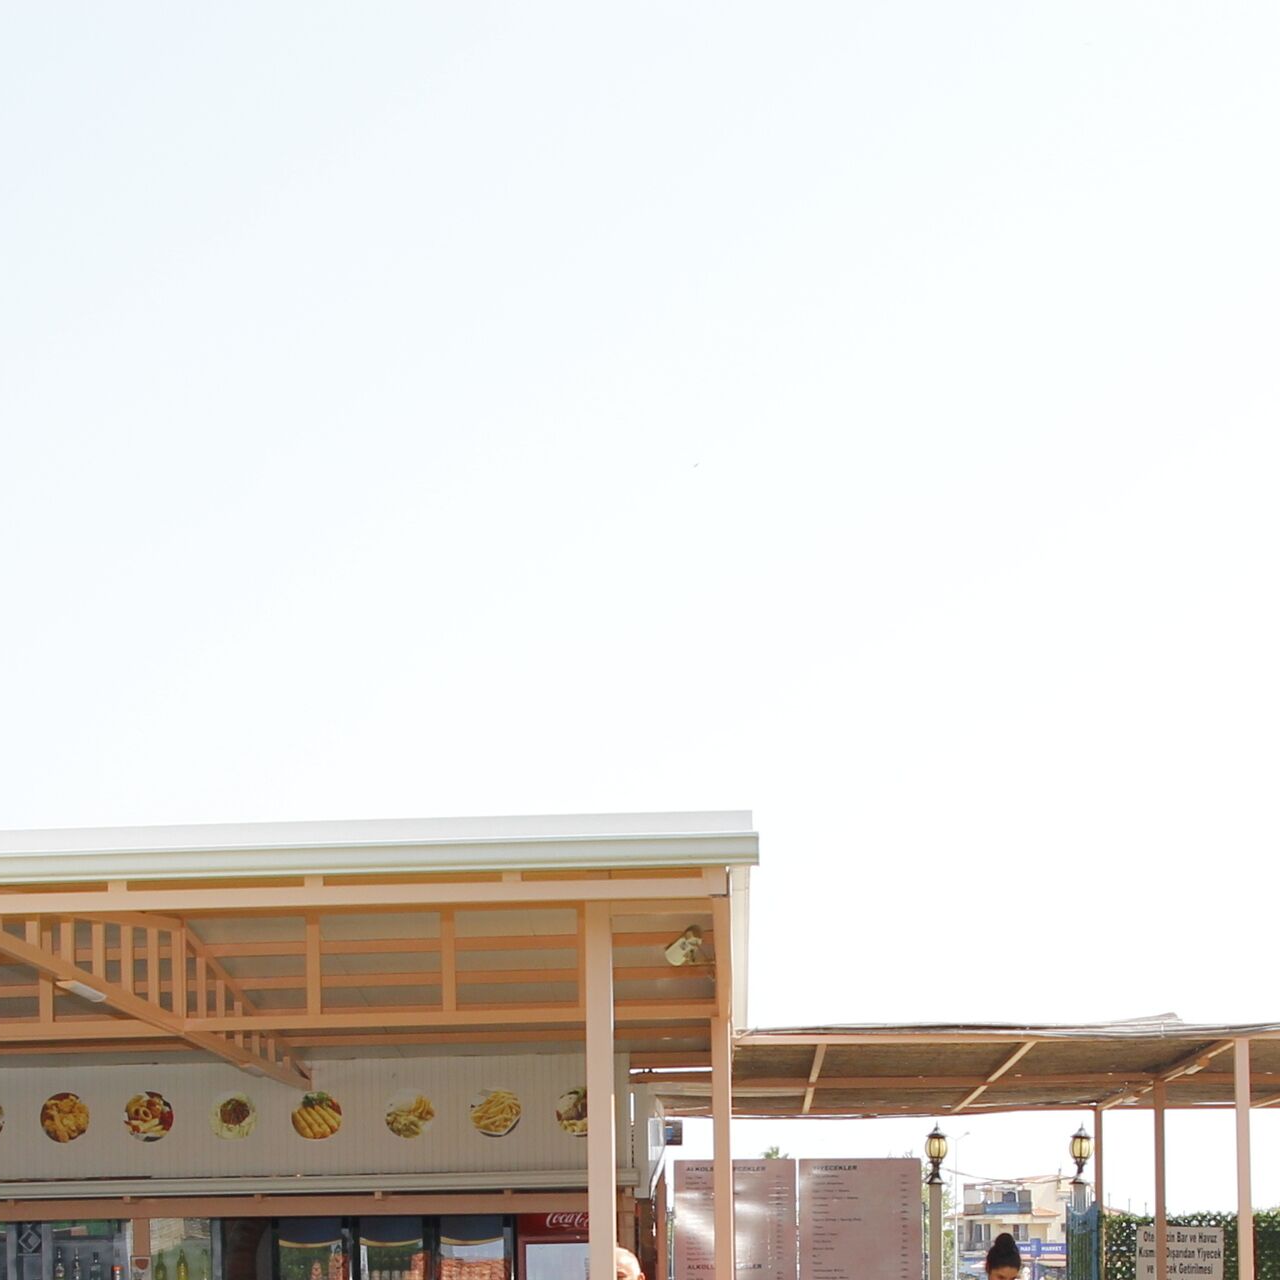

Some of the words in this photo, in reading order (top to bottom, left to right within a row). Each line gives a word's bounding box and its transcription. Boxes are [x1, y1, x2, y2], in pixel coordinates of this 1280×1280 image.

[1176, 1231, 1188, 1243] Bar
[1189, 1234, 1197, 1243] ve
[1198, 1232, 1217, 1243] Havuz
[1197, 1247, 1222, 1262] Yiyecek
[1146, 1264, 1154, 1274] ve
[1178, 1262, 1213, 1274] Getirilmesi
